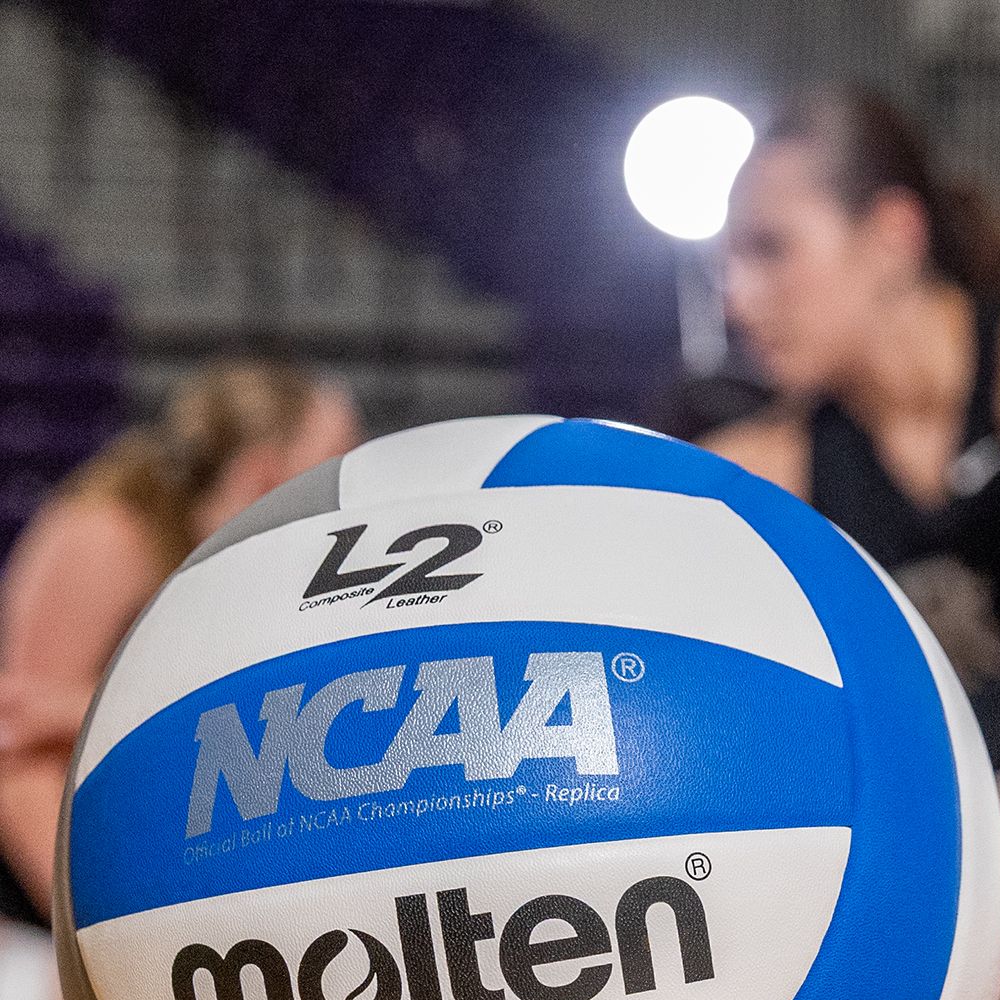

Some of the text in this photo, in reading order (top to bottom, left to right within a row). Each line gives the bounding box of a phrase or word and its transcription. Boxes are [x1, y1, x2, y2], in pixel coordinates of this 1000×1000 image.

[299, 587, 374, 612] Composite
[386, 593, 448, 609] Leather
[183, 831, 237, 866] Official
[241, 821, 273, 846] Ball
[277, 816, 296, 839] of
[300, 806, 350, 832] NCAA
[545, 783, 620, 806] Replica
